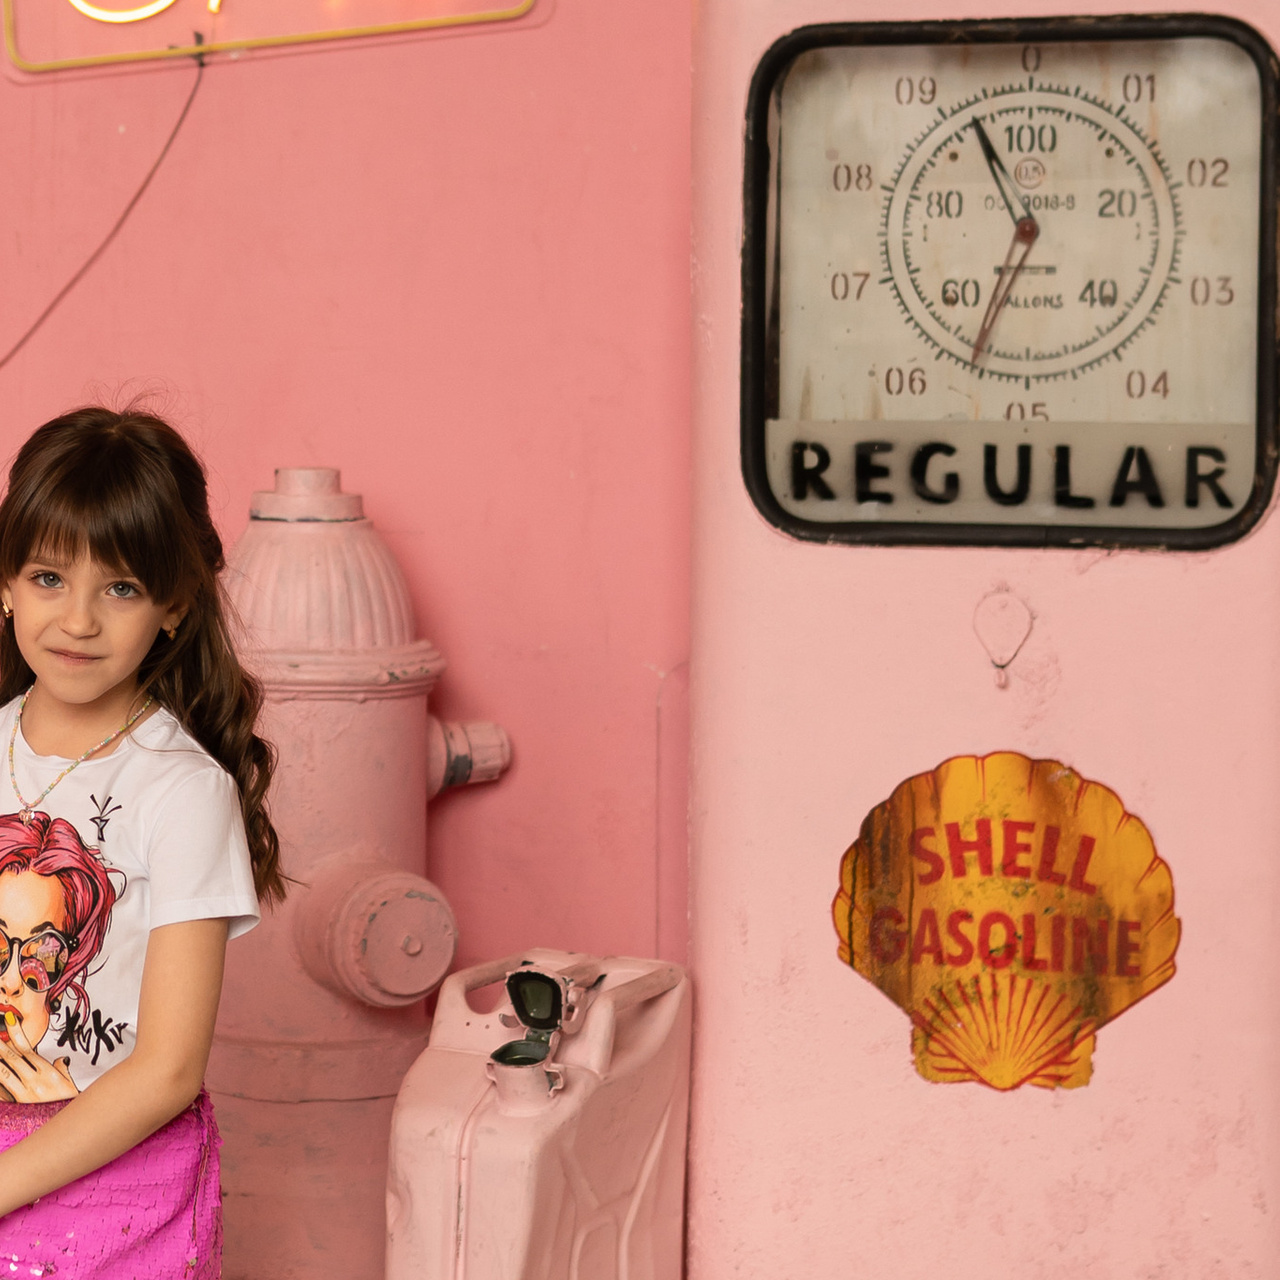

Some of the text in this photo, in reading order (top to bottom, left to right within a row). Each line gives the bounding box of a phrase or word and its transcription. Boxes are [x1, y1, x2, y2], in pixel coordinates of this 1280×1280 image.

[1021, 46, 1041, 72] 0
[894, 76, 936, 106] 09
[1123, 73, 1156, 104] 01
[1005, 125, 1057, 154] 100
[833, 164, 873, 192] 08
[1187, 159, 1230, 188] 02
[926, 191, 963, 218] 80
[1098, 189, 1137, 218] 20
[831, 273, 870, 301] 07
[942, 279, 980, 308] 60
[1079, 280, 1118, 308] 40
[1190, 277, 1234, 306] 03
[1001, 294, 1064, 310] ALLONS
[885, 368, 927, 397] 06
[1126, 371, 1170, 400] 04
[790, 440, 1234, 509] REGULAR
[909, 818, 1097, 896] SHELL
[870, 906, 1142, 977] GASOLINE
